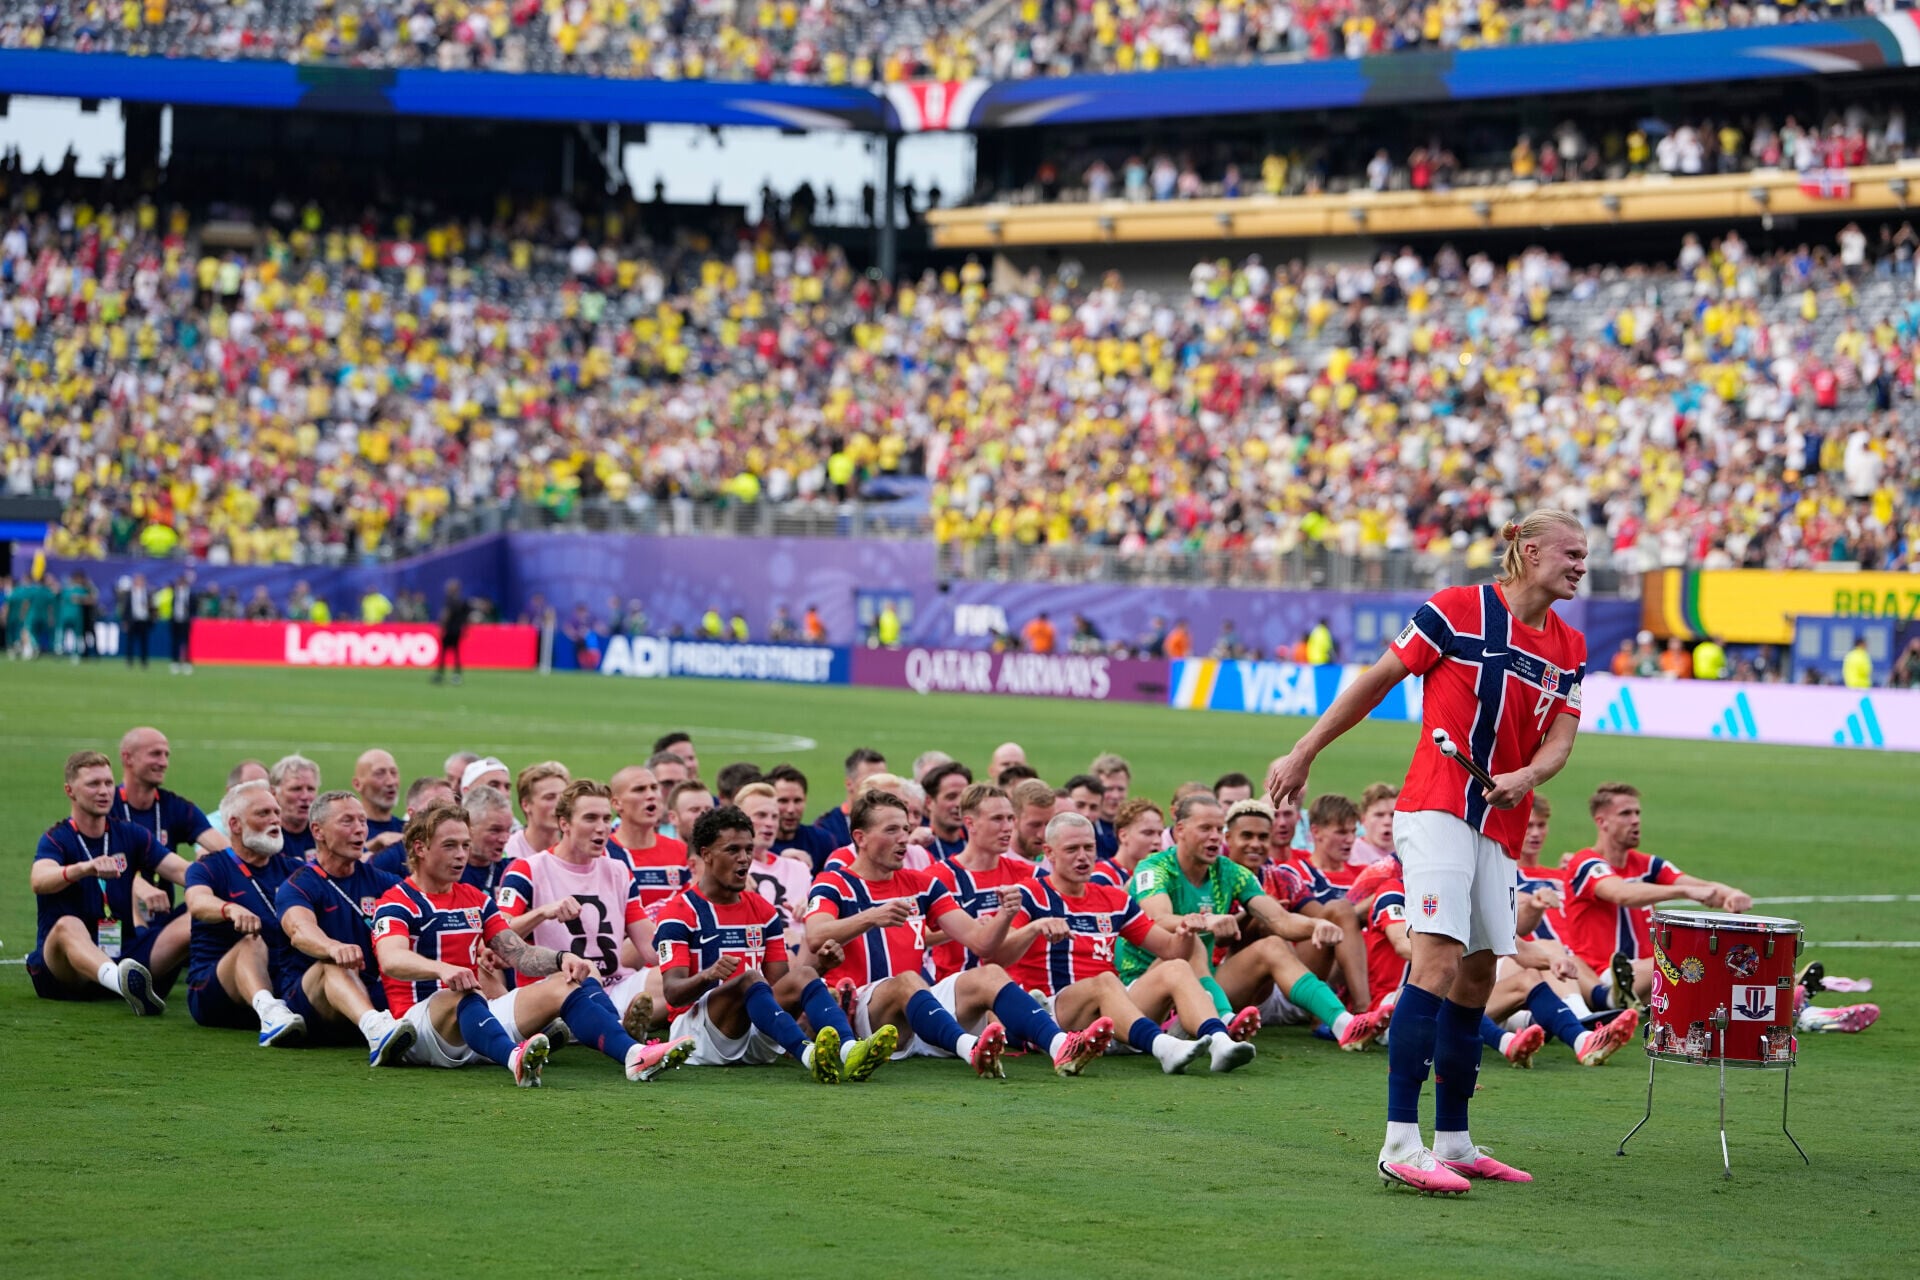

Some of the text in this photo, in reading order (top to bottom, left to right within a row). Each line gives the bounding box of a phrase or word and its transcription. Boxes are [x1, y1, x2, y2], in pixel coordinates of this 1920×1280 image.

[285, 623, 439, 666] Lenovo
[905, 648, 1111, 699] QATAR AIRWAYS
[1237, 661, 1318, 716] VISA
[1534, 692, 1555, 730] 9
[908, 920, 925, 950] 8
